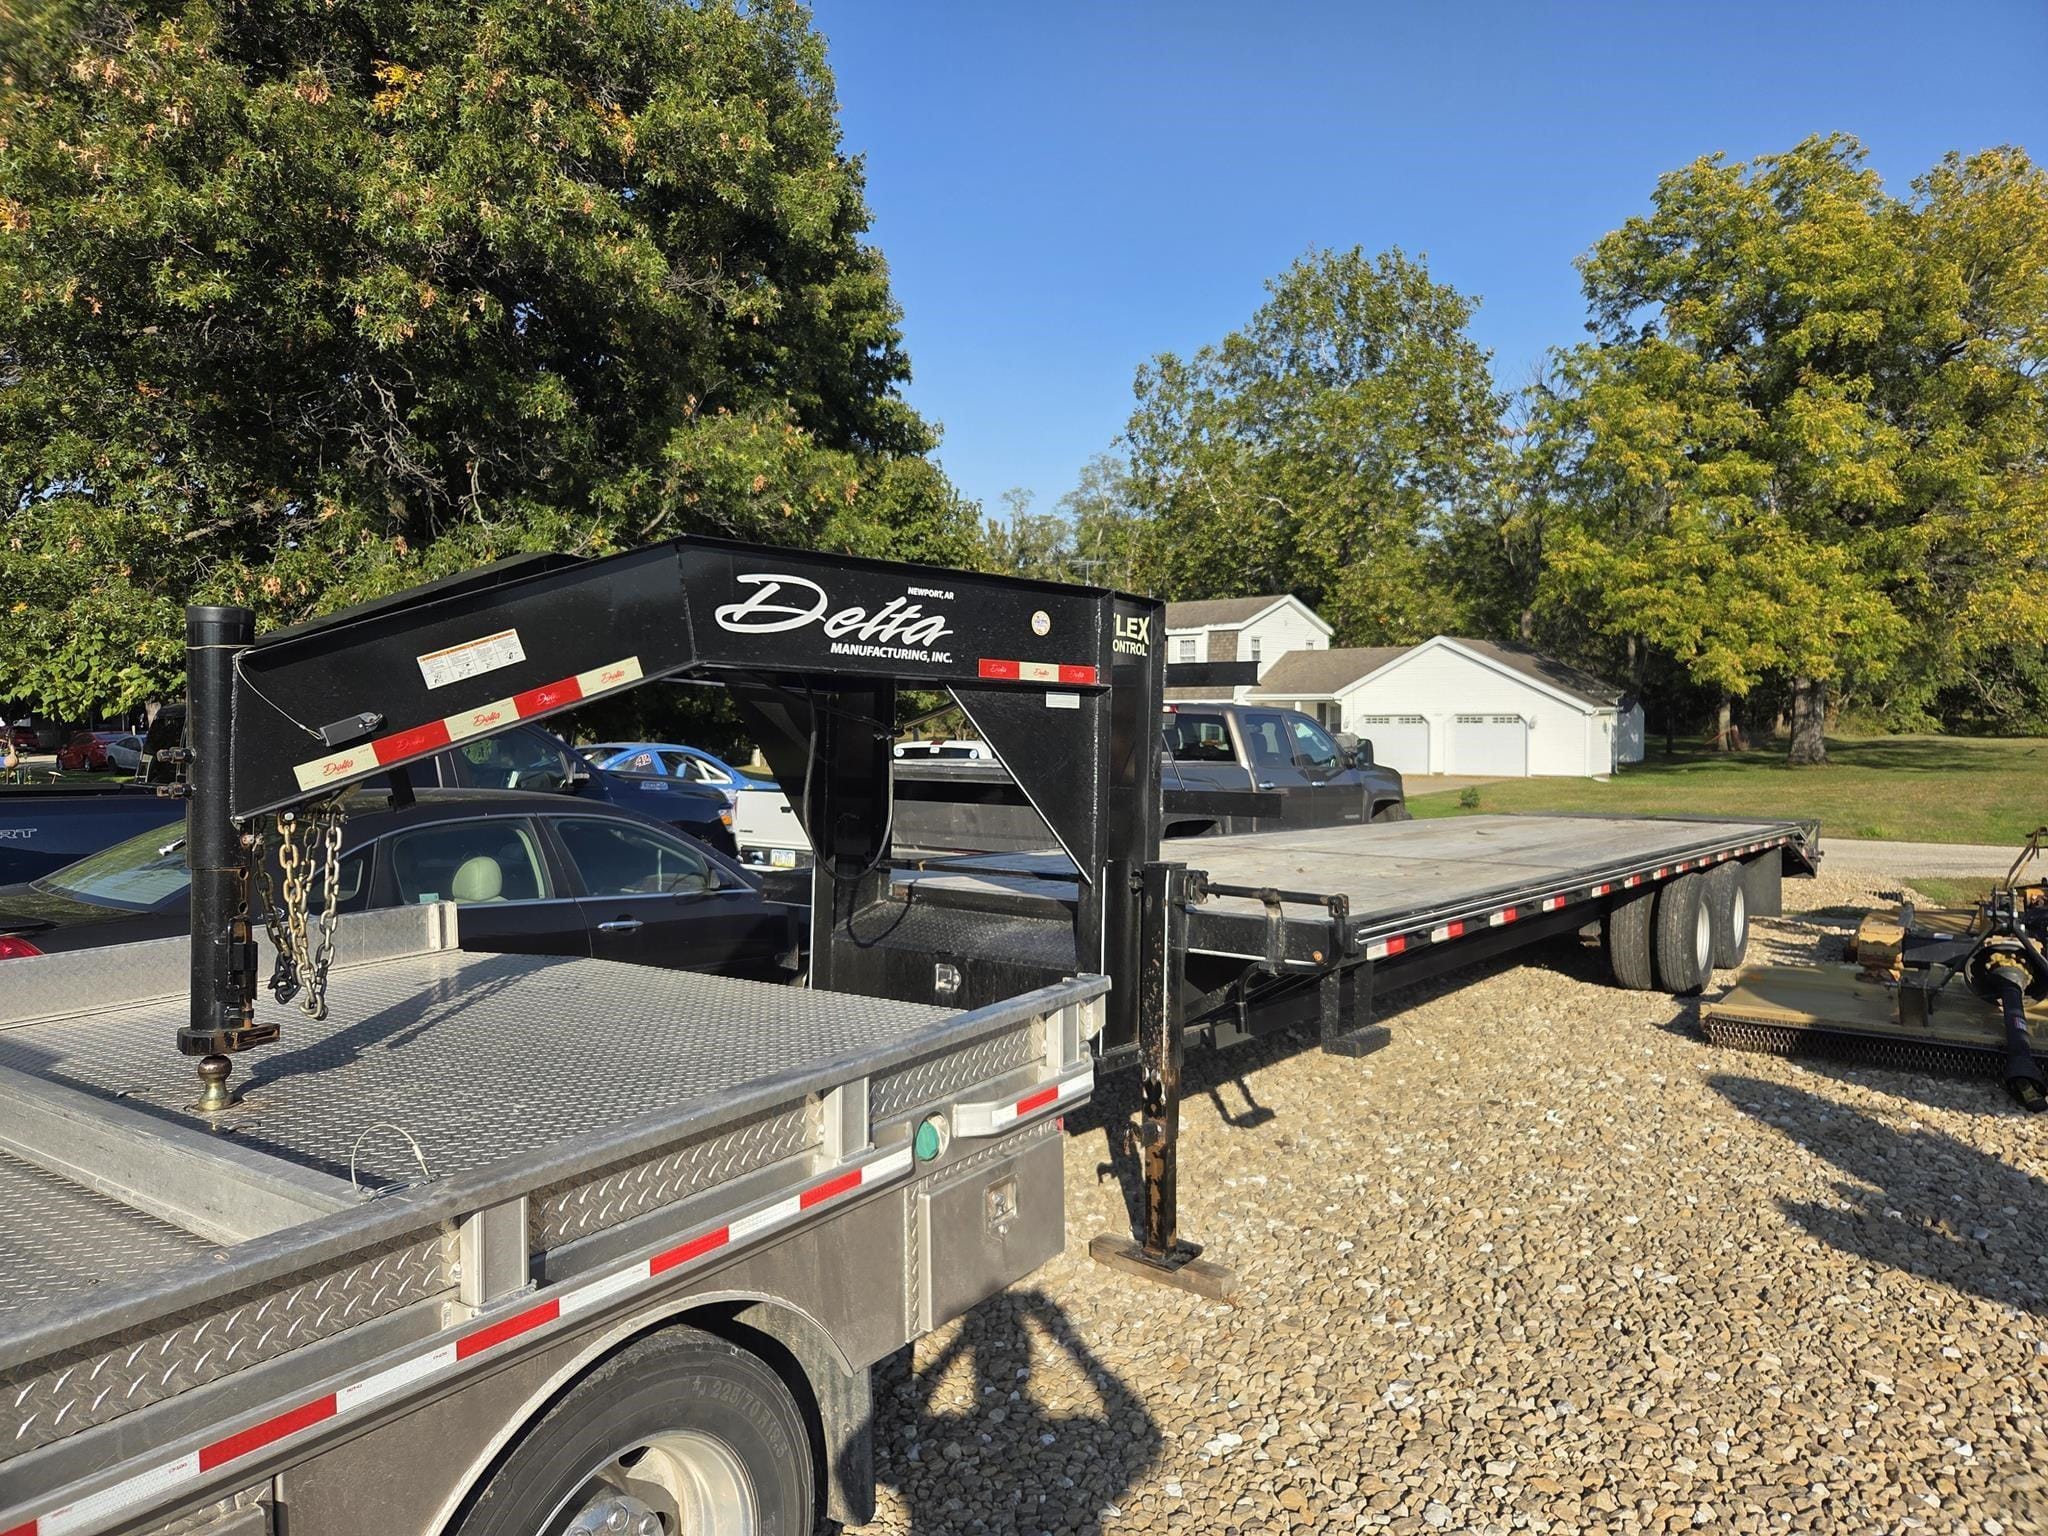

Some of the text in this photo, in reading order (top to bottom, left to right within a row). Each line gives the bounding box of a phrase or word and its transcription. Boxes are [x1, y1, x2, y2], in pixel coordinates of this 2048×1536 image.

[907, 586, 955, 600] NEWPORT, AR
[715, 573, 954, 647] Delta
[1113, 612, 1150, 646] LEX
[830, 642, 953, 664] MANUFACTURING, INC.
[1112, 638, 1148, 657] ONTROL
